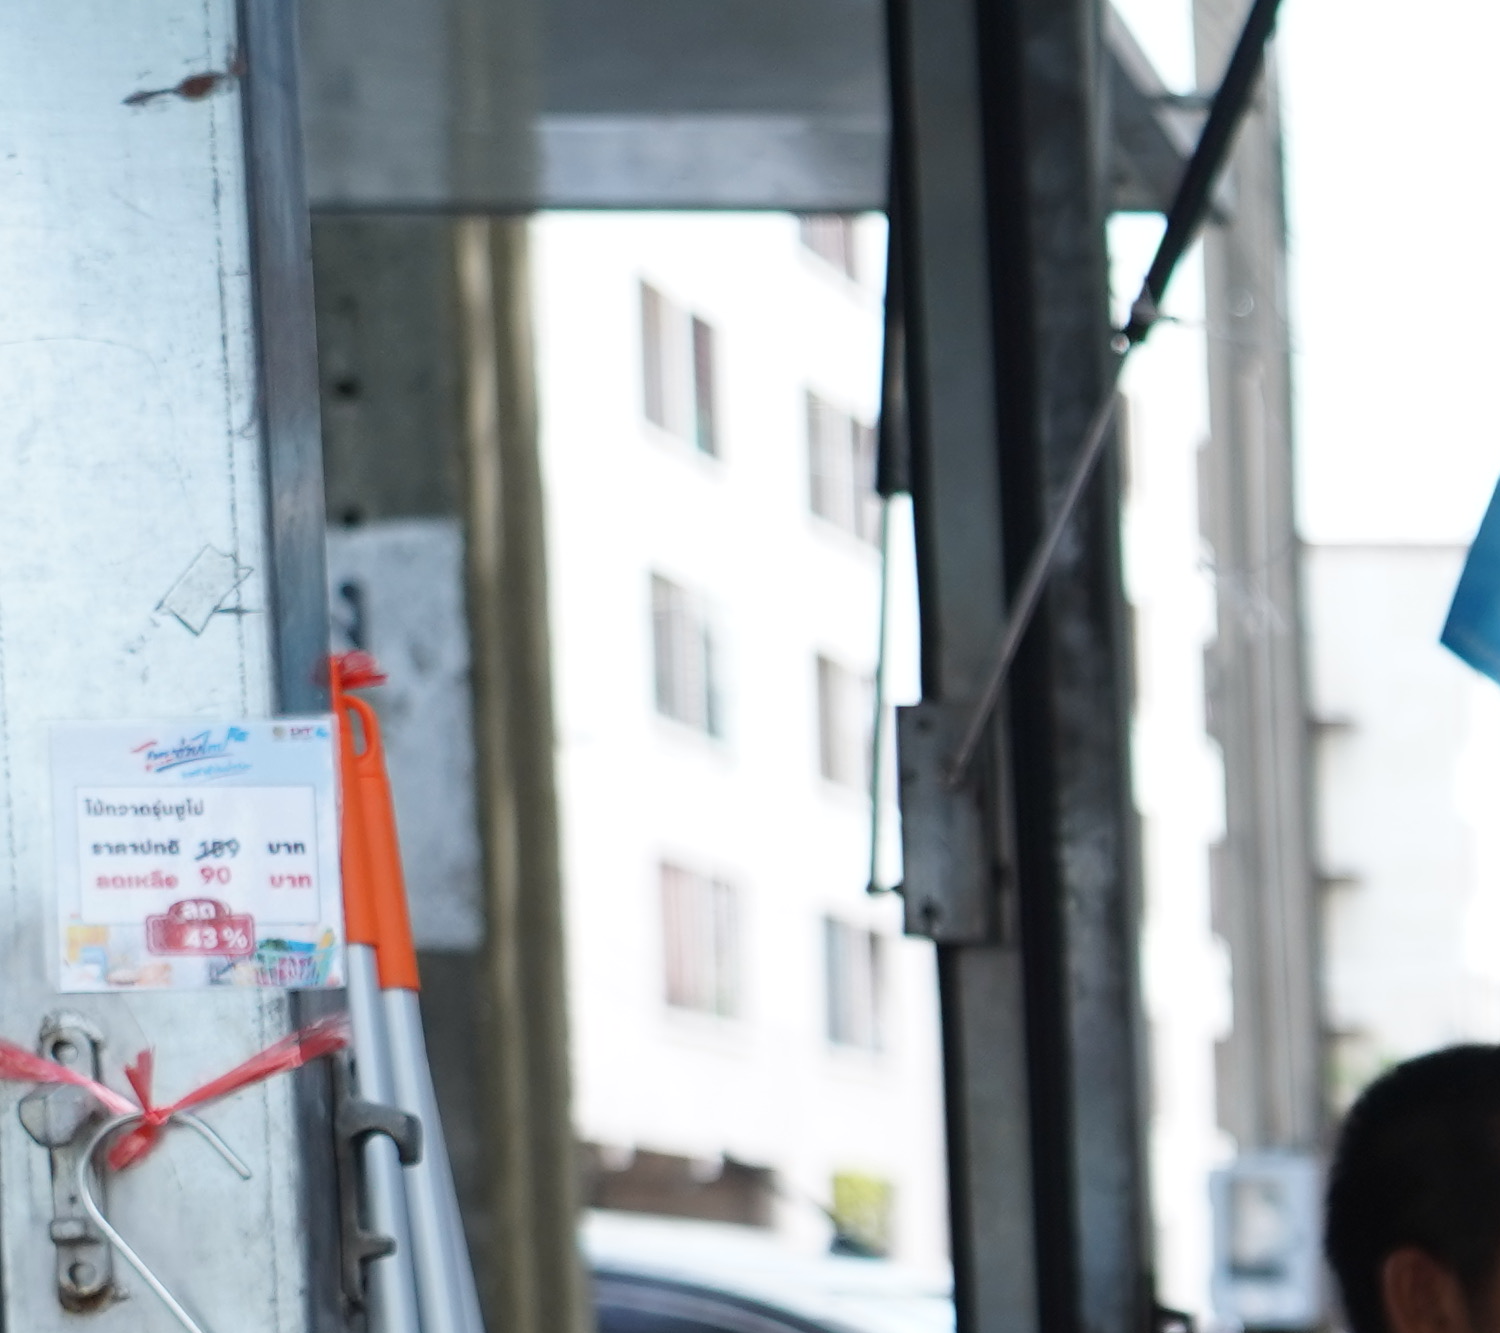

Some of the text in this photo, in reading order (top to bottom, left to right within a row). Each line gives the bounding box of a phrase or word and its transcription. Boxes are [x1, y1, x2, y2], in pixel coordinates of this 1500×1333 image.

[268, 840, 307, 856] บาท
[200, 866, 233, 886] 90
[270, 872, 313, 890] บาท
[183, 926, 219, 949] 43
